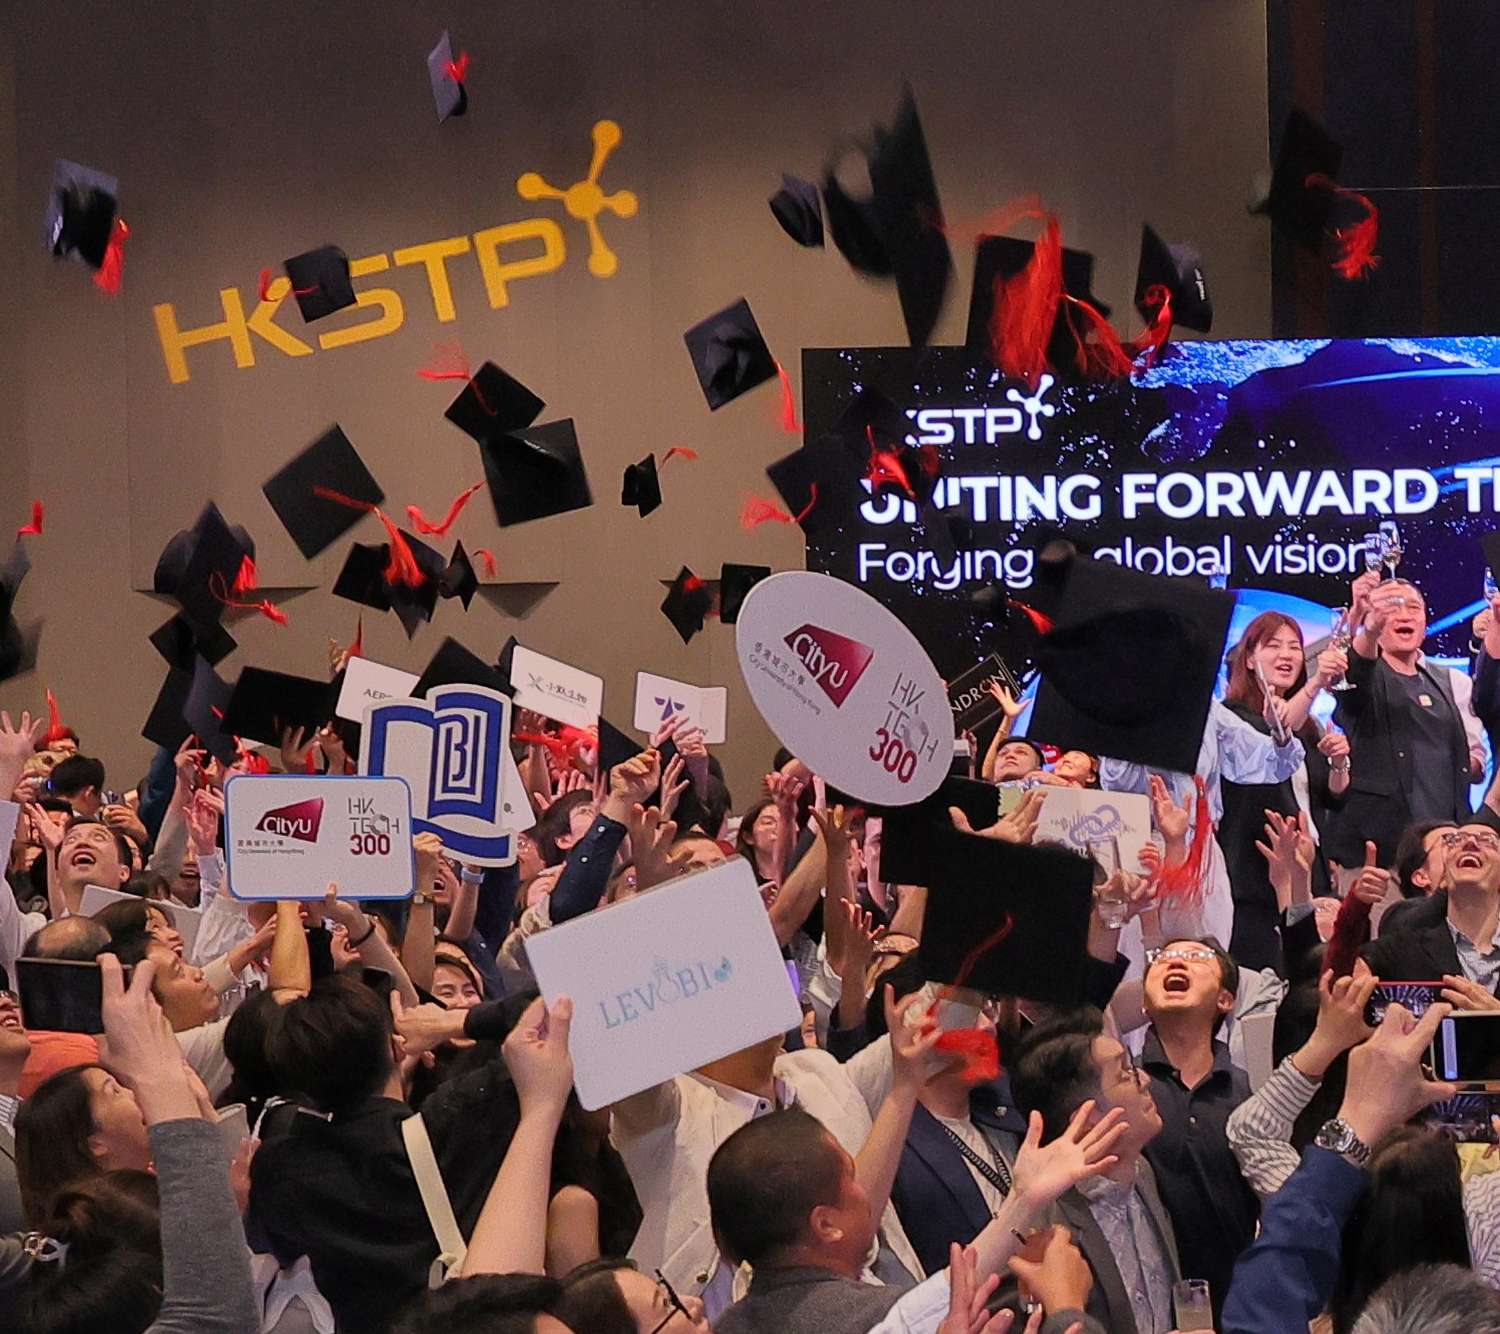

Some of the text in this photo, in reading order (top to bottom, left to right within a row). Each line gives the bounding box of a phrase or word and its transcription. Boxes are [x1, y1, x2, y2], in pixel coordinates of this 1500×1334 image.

[152, 217, 567, 385] HKSTP
[904, 407, 1023, 446] STP
[1122, 467, 1440, 520] FORWARD
[792, 632, 850, 690] CityU
[869, 727, 918, 783] 300
[262, 816, 312, 837] CityU
[348, 796, 376, 815] HK
[350, 833, 391, 856] 300
